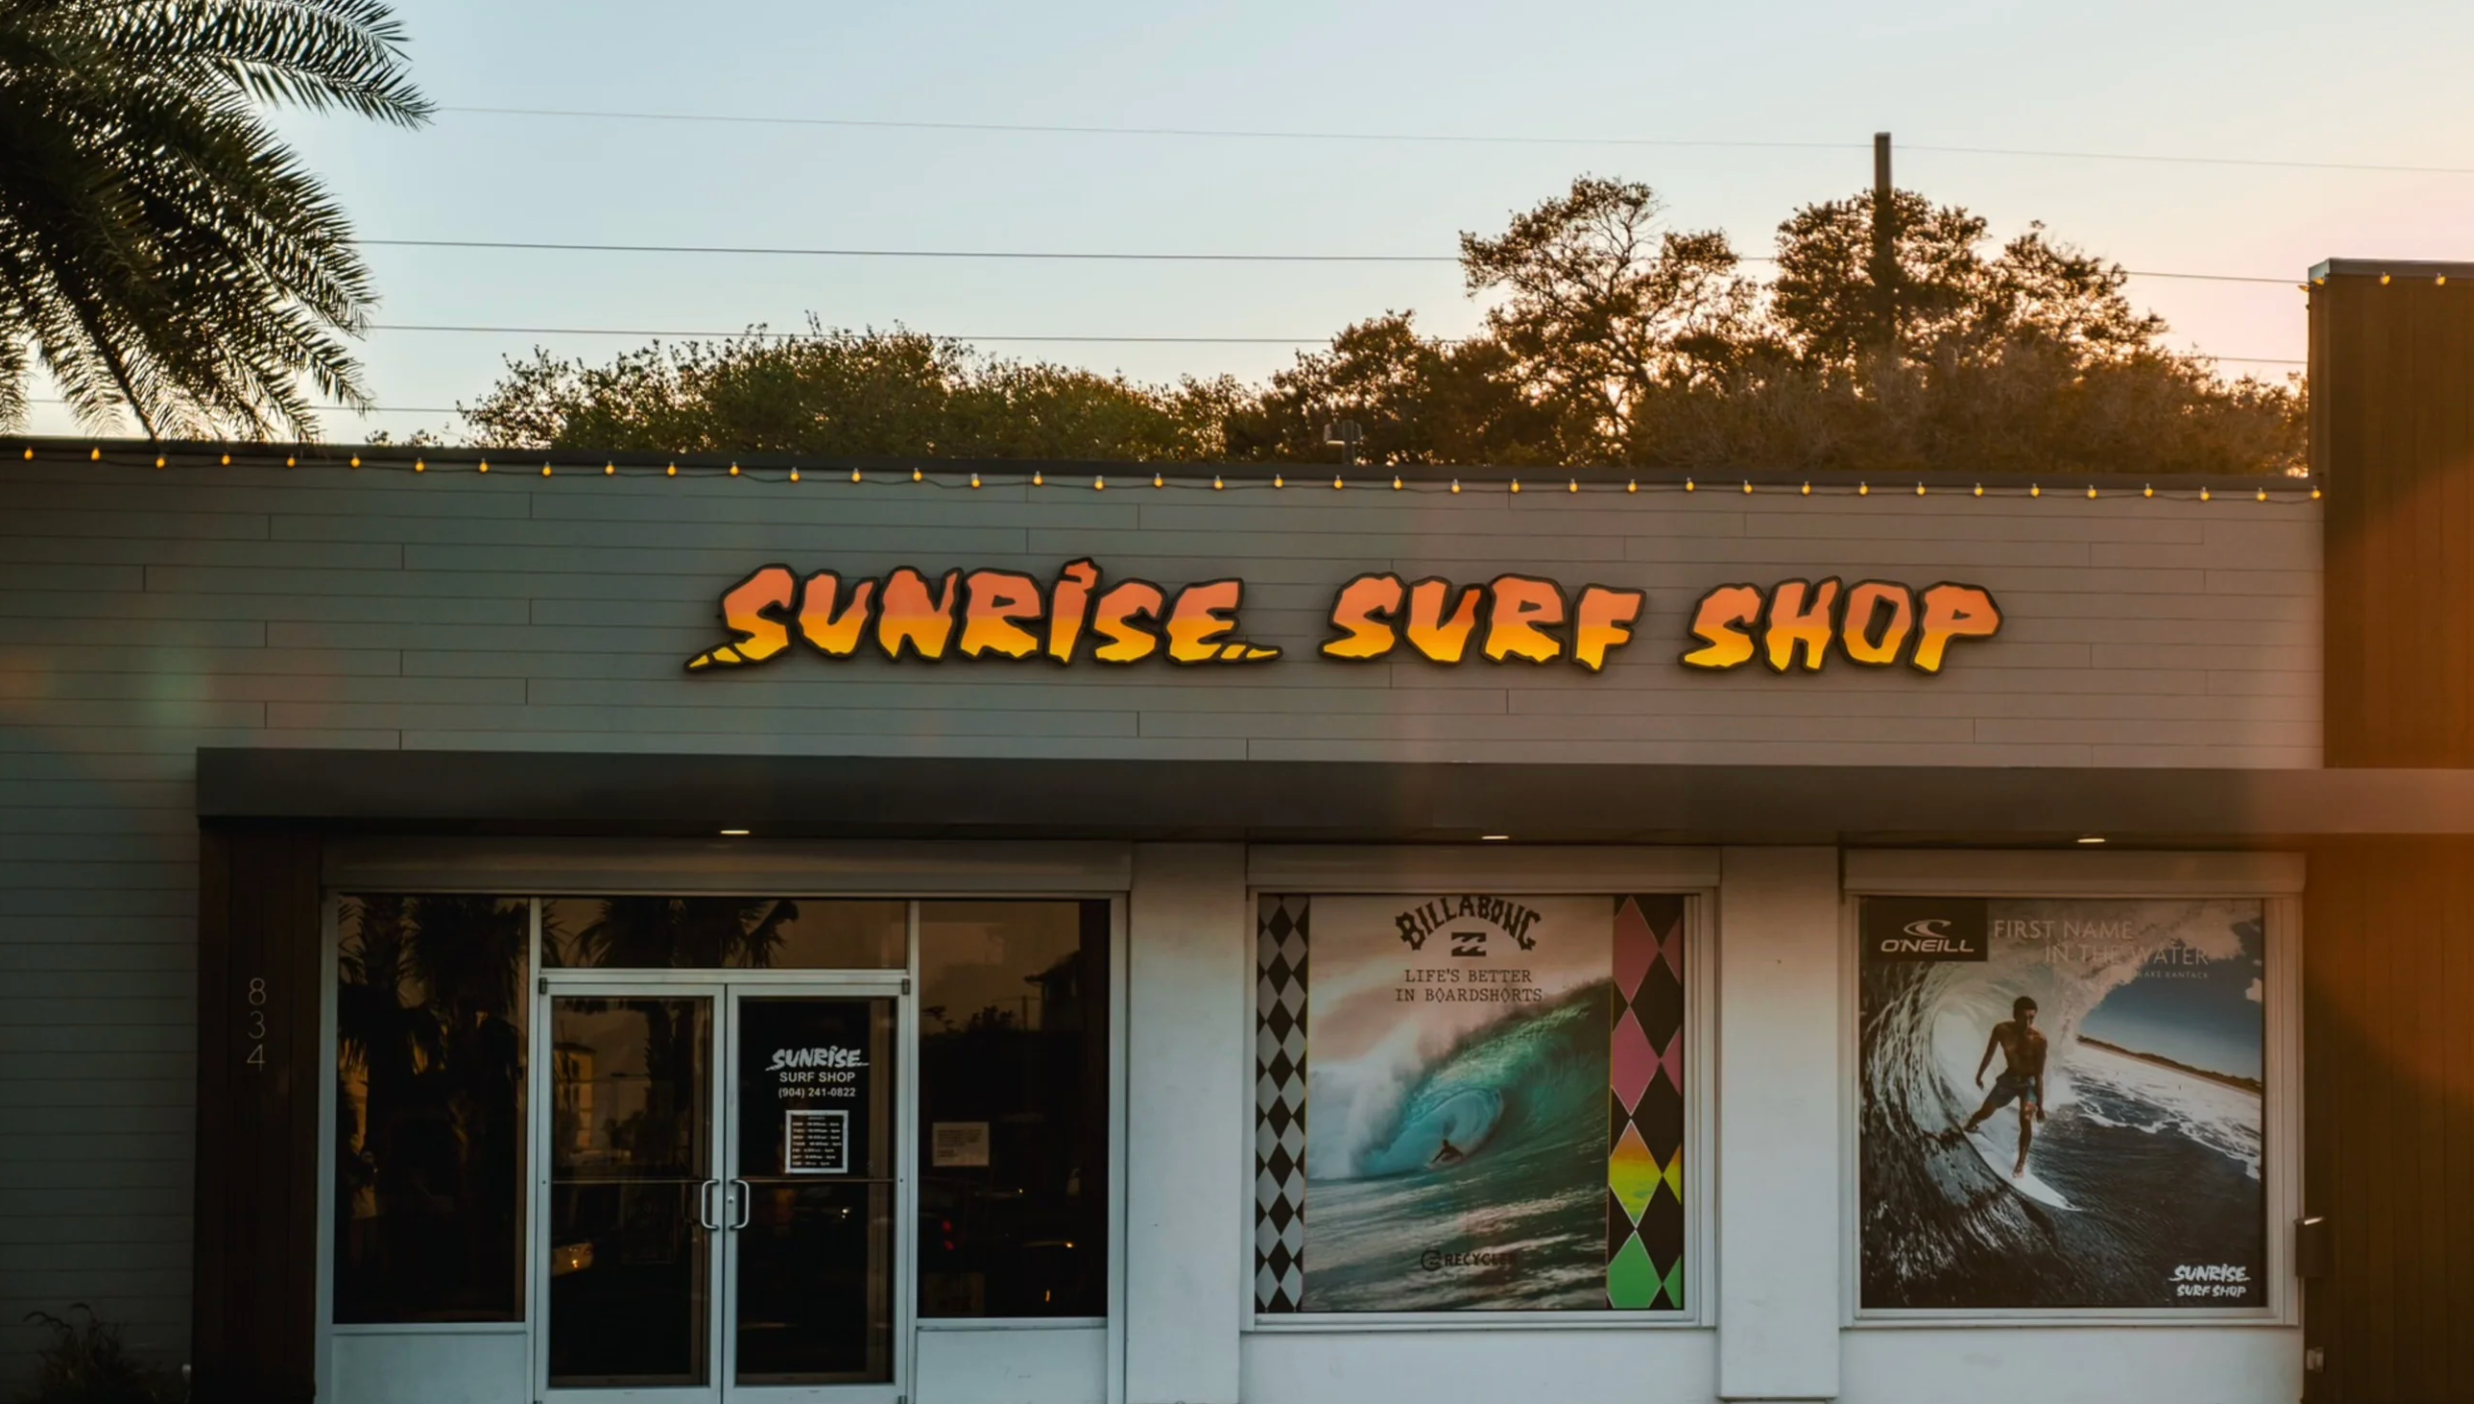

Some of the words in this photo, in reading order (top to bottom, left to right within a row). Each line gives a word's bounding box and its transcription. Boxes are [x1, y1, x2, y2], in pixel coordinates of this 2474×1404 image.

[1317, 572, 1646, 673] SURF
[1679, 576, 2003, 675] SHOP
[1395, 895, 1542, 951] BILLABONG
[1994, 920, 2055, 939] FIRST
[2063, 920, 2133, 940] NAME
[1880, 939, 1975, 953] O'NEILL
[2045, 945, 2069, 964] IN
[2077, 944, 2121, 965] THE
[2130, 945, 2209, 966] WATER
[1404, 969, 1460, 983] LIFE'S
[1468, 969, 1533, 983] BETTER
[1395, 988, 1415, 1002] IN
[1425, 987, 1543, 1003] BOARDSHORTS
[246, 977, 267, 1072] 834
[779, 1071, 815, 1083] SURF
[818, 1071, 856, 1083] SHOP
[778, 1087, 805, 1099] (904)
[808, 1087, 856, 1098] 241-0822
[2176, 1283, 2211, 1297] SURF
[2212, 1284, 2247, 1298] SHOP
